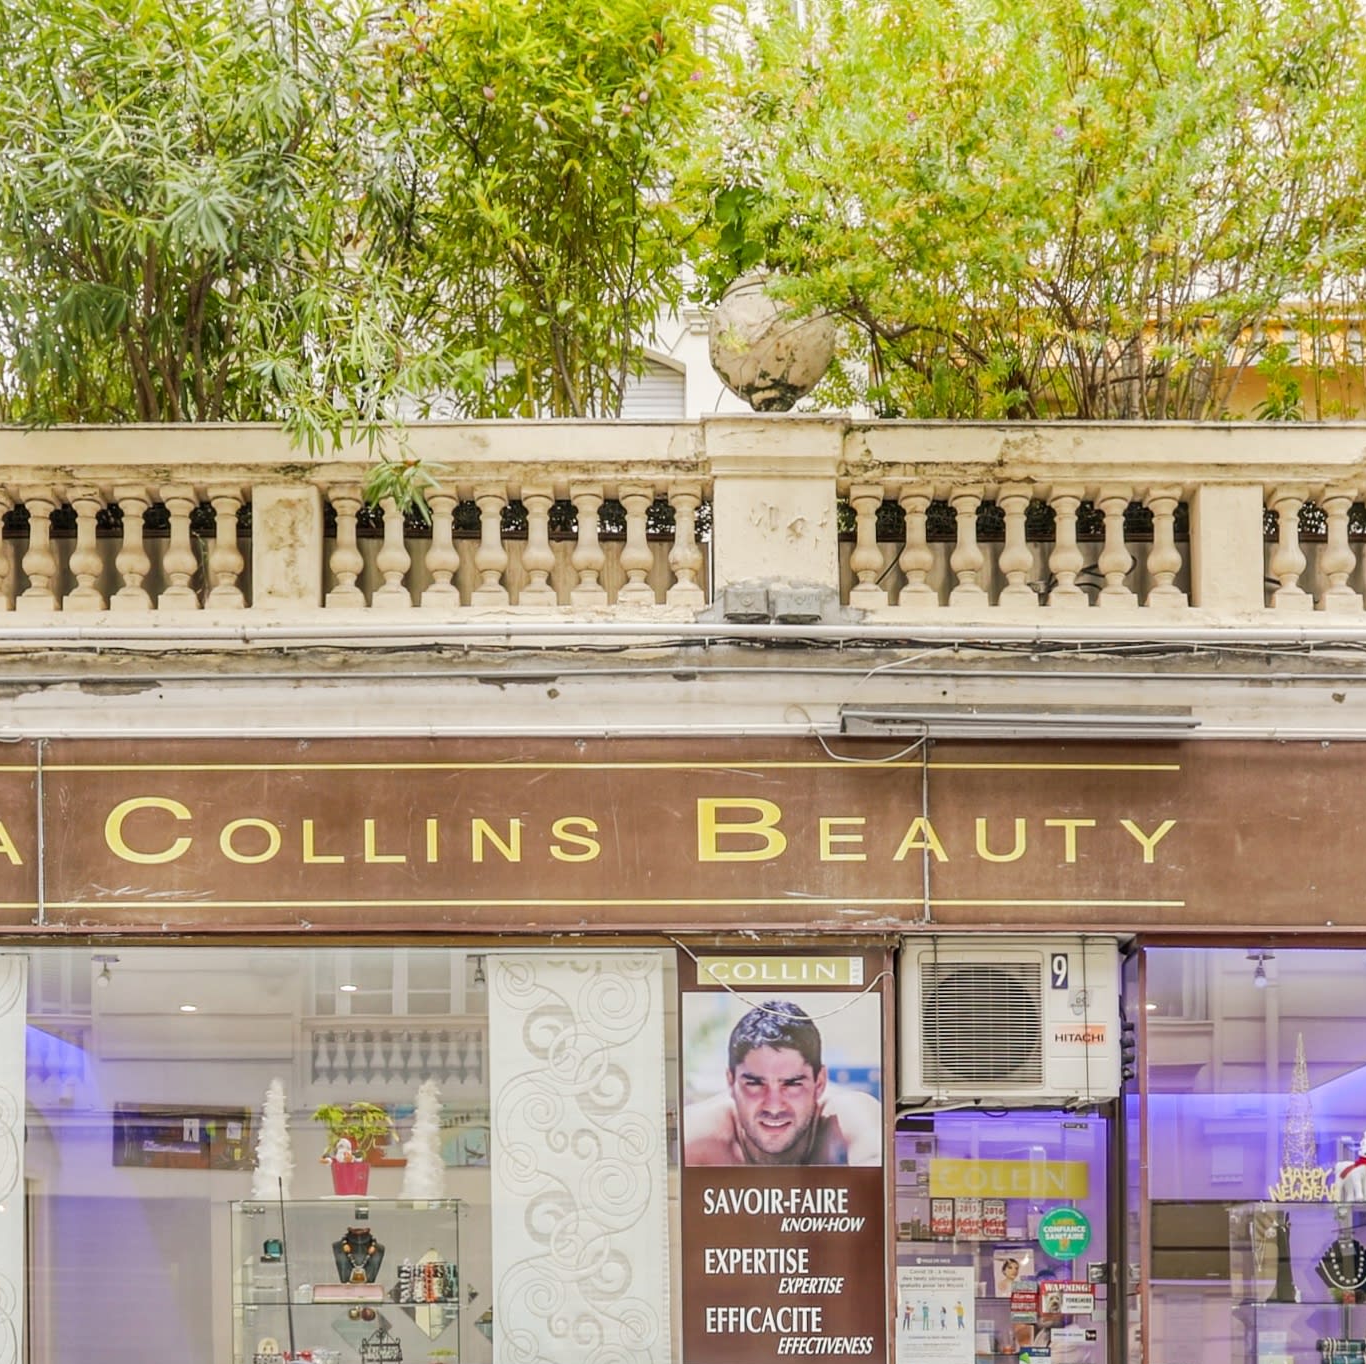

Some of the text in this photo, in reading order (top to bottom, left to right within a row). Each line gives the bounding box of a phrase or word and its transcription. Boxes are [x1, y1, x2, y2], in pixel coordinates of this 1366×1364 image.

[104, 796, 601, 864] COLLINS
[696, 797, 1177, 864] BEAUTY
[707, 962, 836, 980] COLLIN
[1052, 955, 1067, 987] 9
[1054, 1033, 1104, 1043] HITACHI
[1280, 1166, 1333, 1186] HAPPY
[703, 1188, 848, 1215] SAVOIR-FAIRE
[780, 1217, 866, 1232] KNOW-HOW
[1043, 1225, 1086, 1233] CONFIANCE
[1045, 1232, 1085, 1240] SANITAIRE
[704, 1248, 809, 1275] EXPERTISE
[778, 1277, 845, 1294] EXPERTISE
[1044, 1283, 1092, 1292] WARNING!
[705, 1307, 823, 1333] EFFICACITE
[777, 1337, 874, 1355] EFFECTIVENESS
